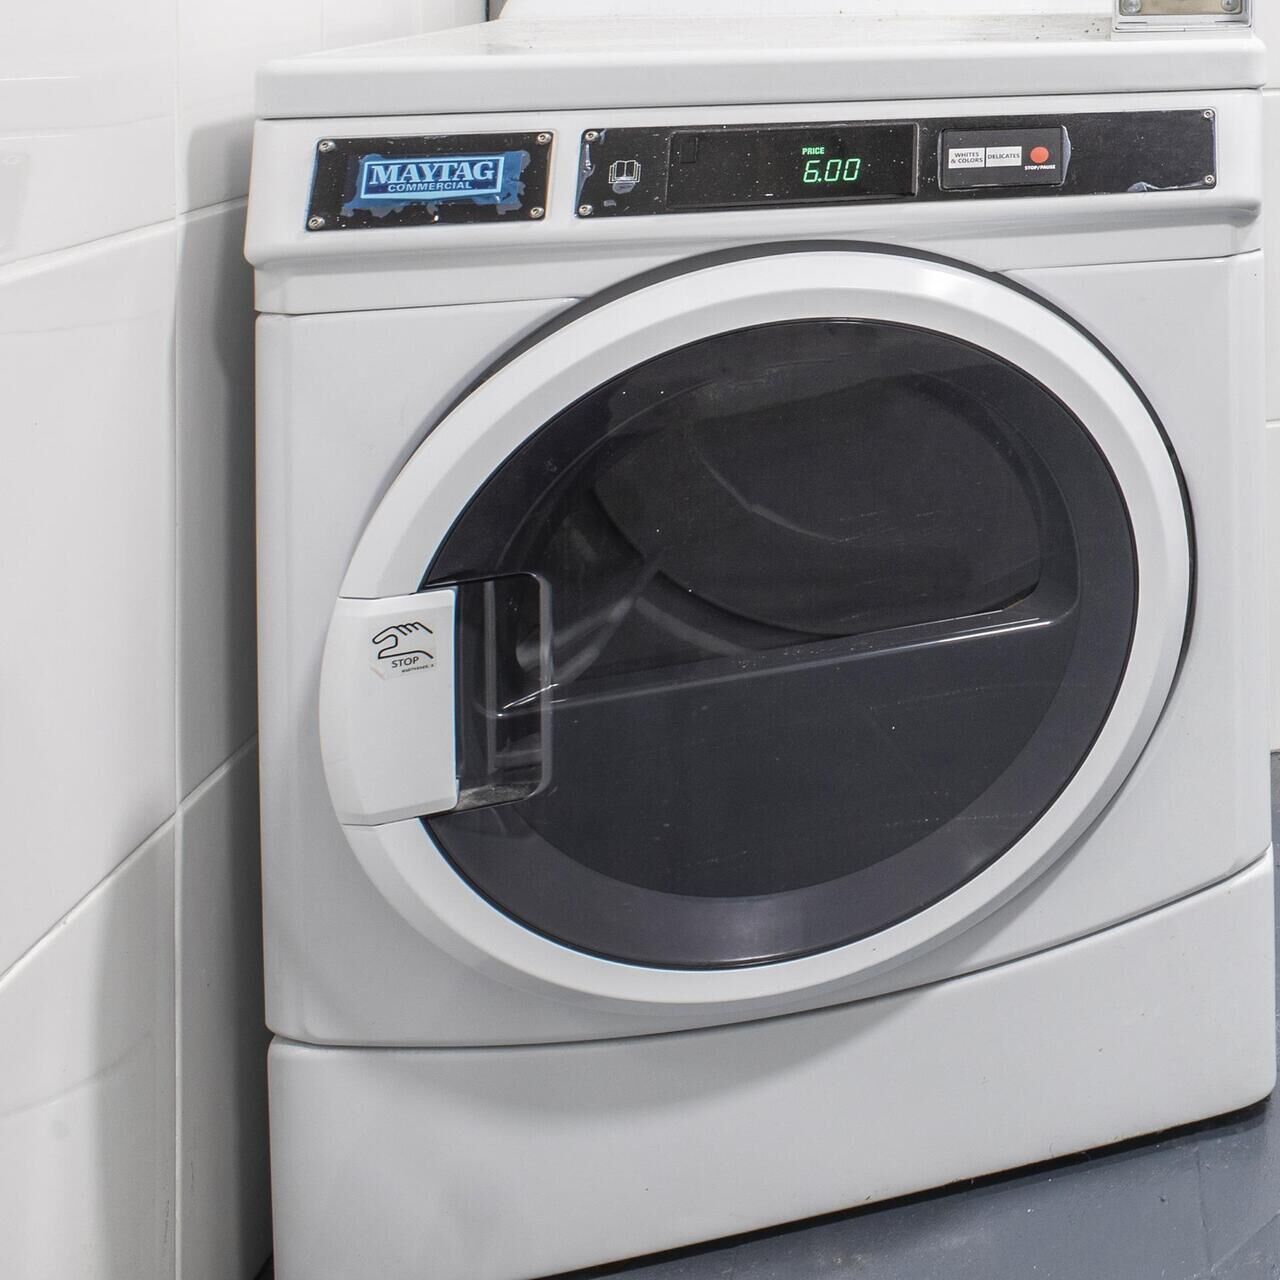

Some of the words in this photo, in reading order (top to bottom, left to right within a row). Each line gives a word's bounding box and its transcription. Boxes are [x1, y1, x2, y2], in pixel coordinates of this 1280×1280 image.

[802, 147, 825, 155] PRICE
[369, 161, 495, 185] MAYTAG
[803, 158, 861, 183] 6.00
[388, 181, 472, 193] COMMERCIAL
[391, 656, 420, 668] STOP
